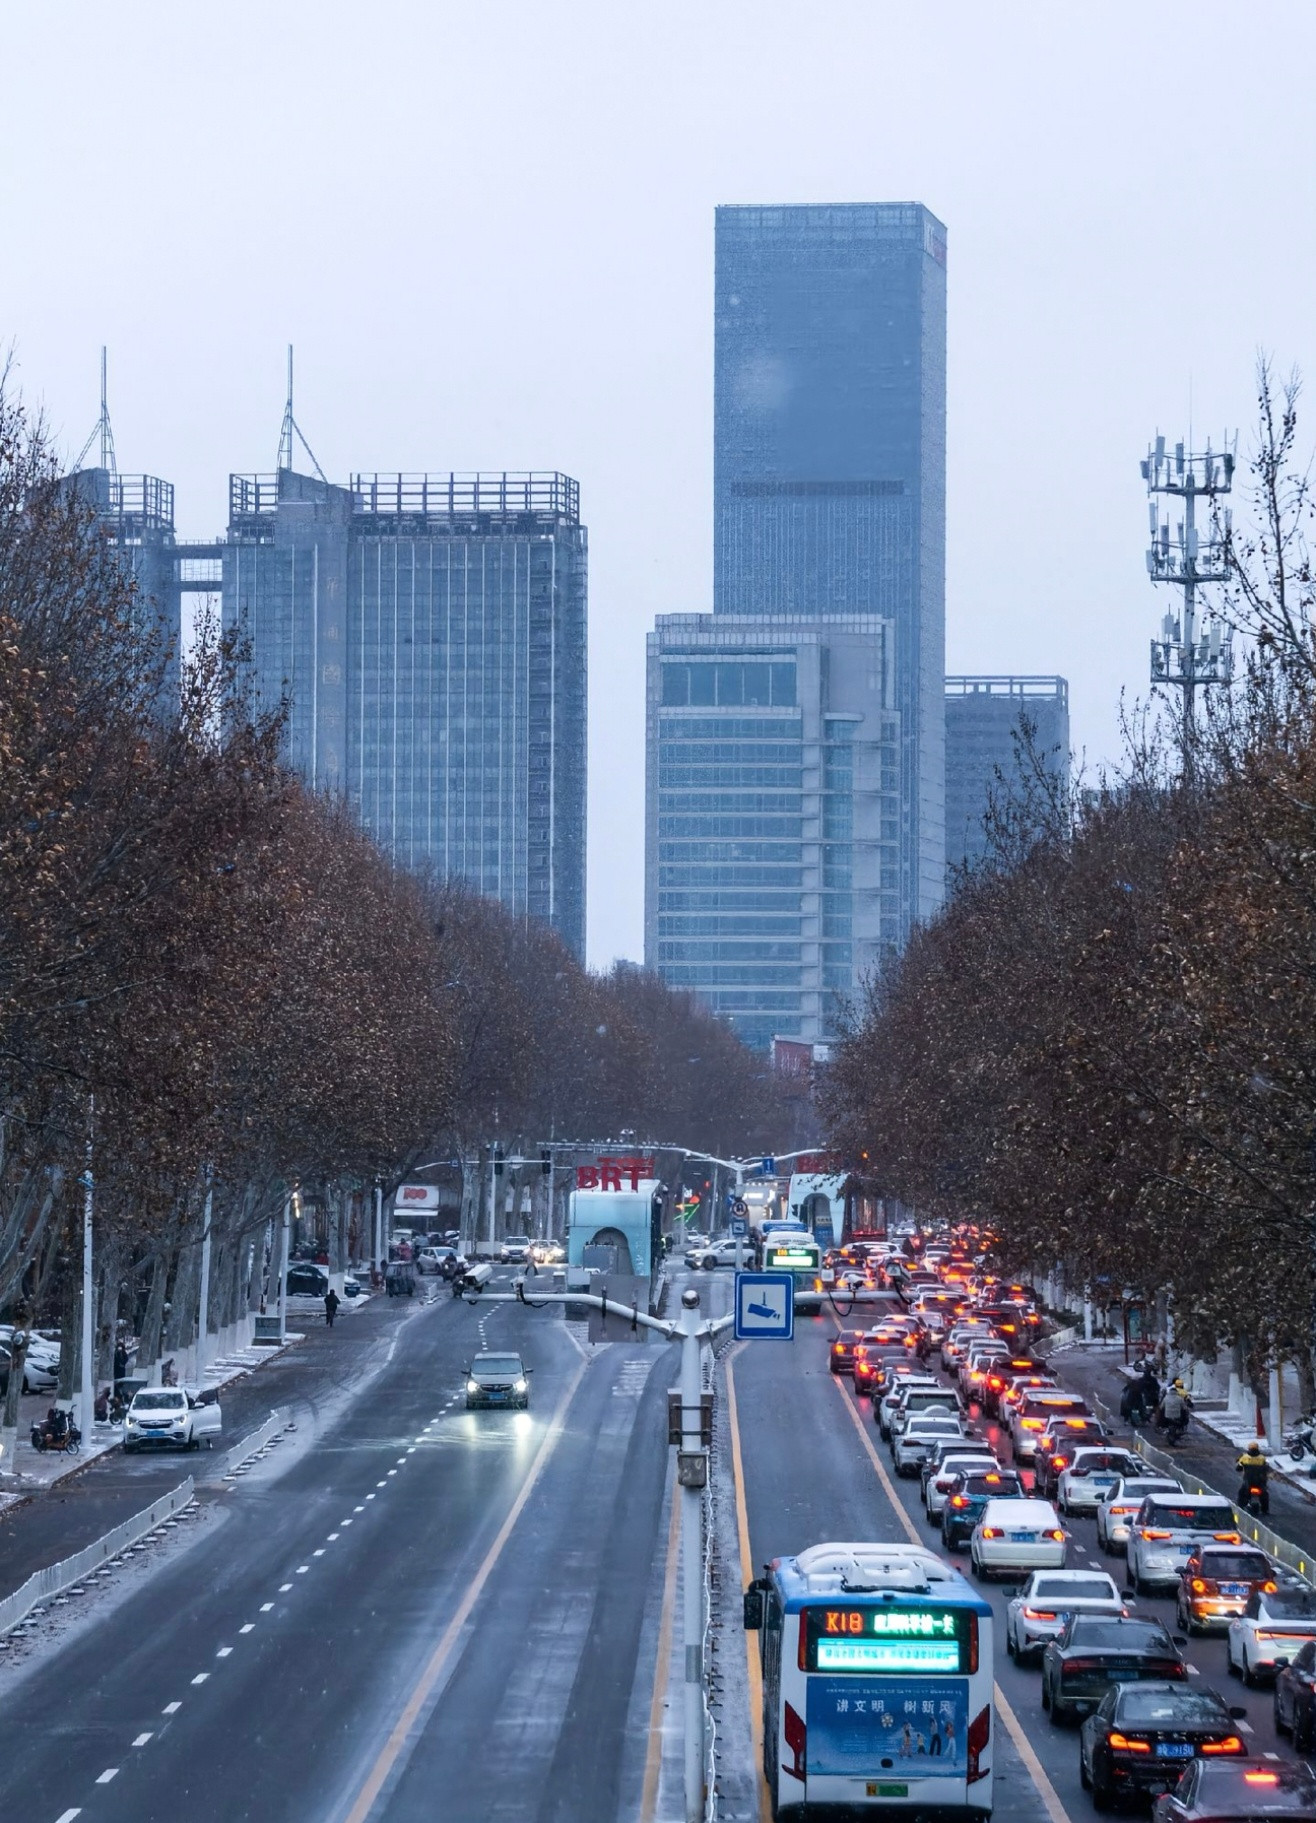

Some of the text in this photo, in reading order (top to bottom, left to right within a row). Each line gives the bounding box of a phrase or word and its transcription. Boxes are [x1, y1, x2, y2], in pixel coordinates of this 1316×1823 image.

[576, 1165, 647, 1193] BRT
[836, 1698, 885, 1714] 讲文明
